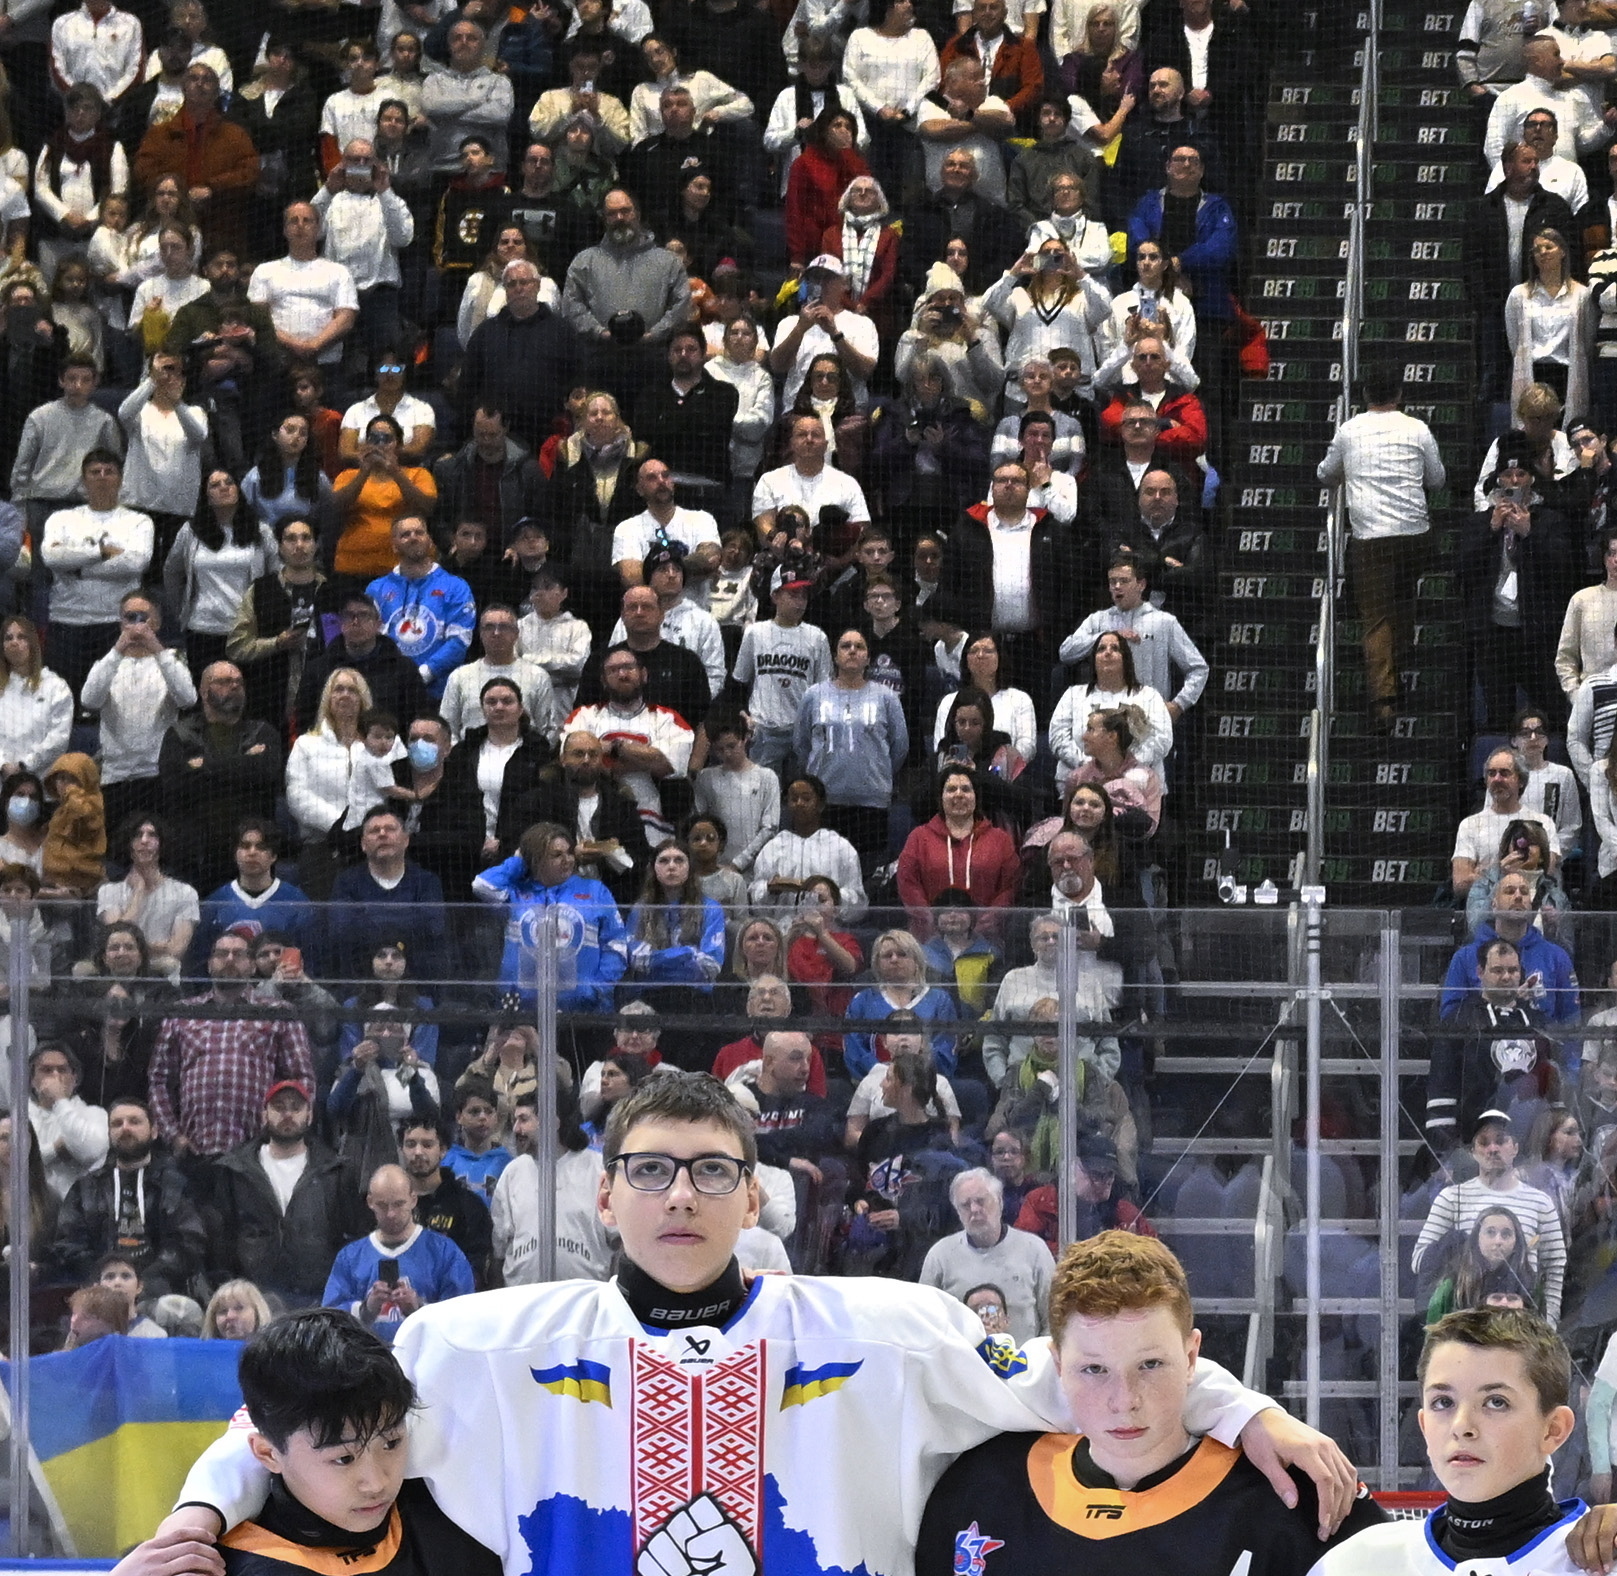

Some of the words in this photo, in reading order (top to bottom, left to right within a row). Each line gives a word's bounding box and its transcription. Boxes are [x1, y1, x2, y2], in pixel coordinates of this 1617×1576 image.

[757, 653, 810, 671] DRAGONS
[650, 1300, 731, 1321] BAUER
[680, 1357, 715, 1365] BAUER
[1086, 1503, 1128, 1521] TPS
[1446, 1515, 1494, 1530] ASTON
